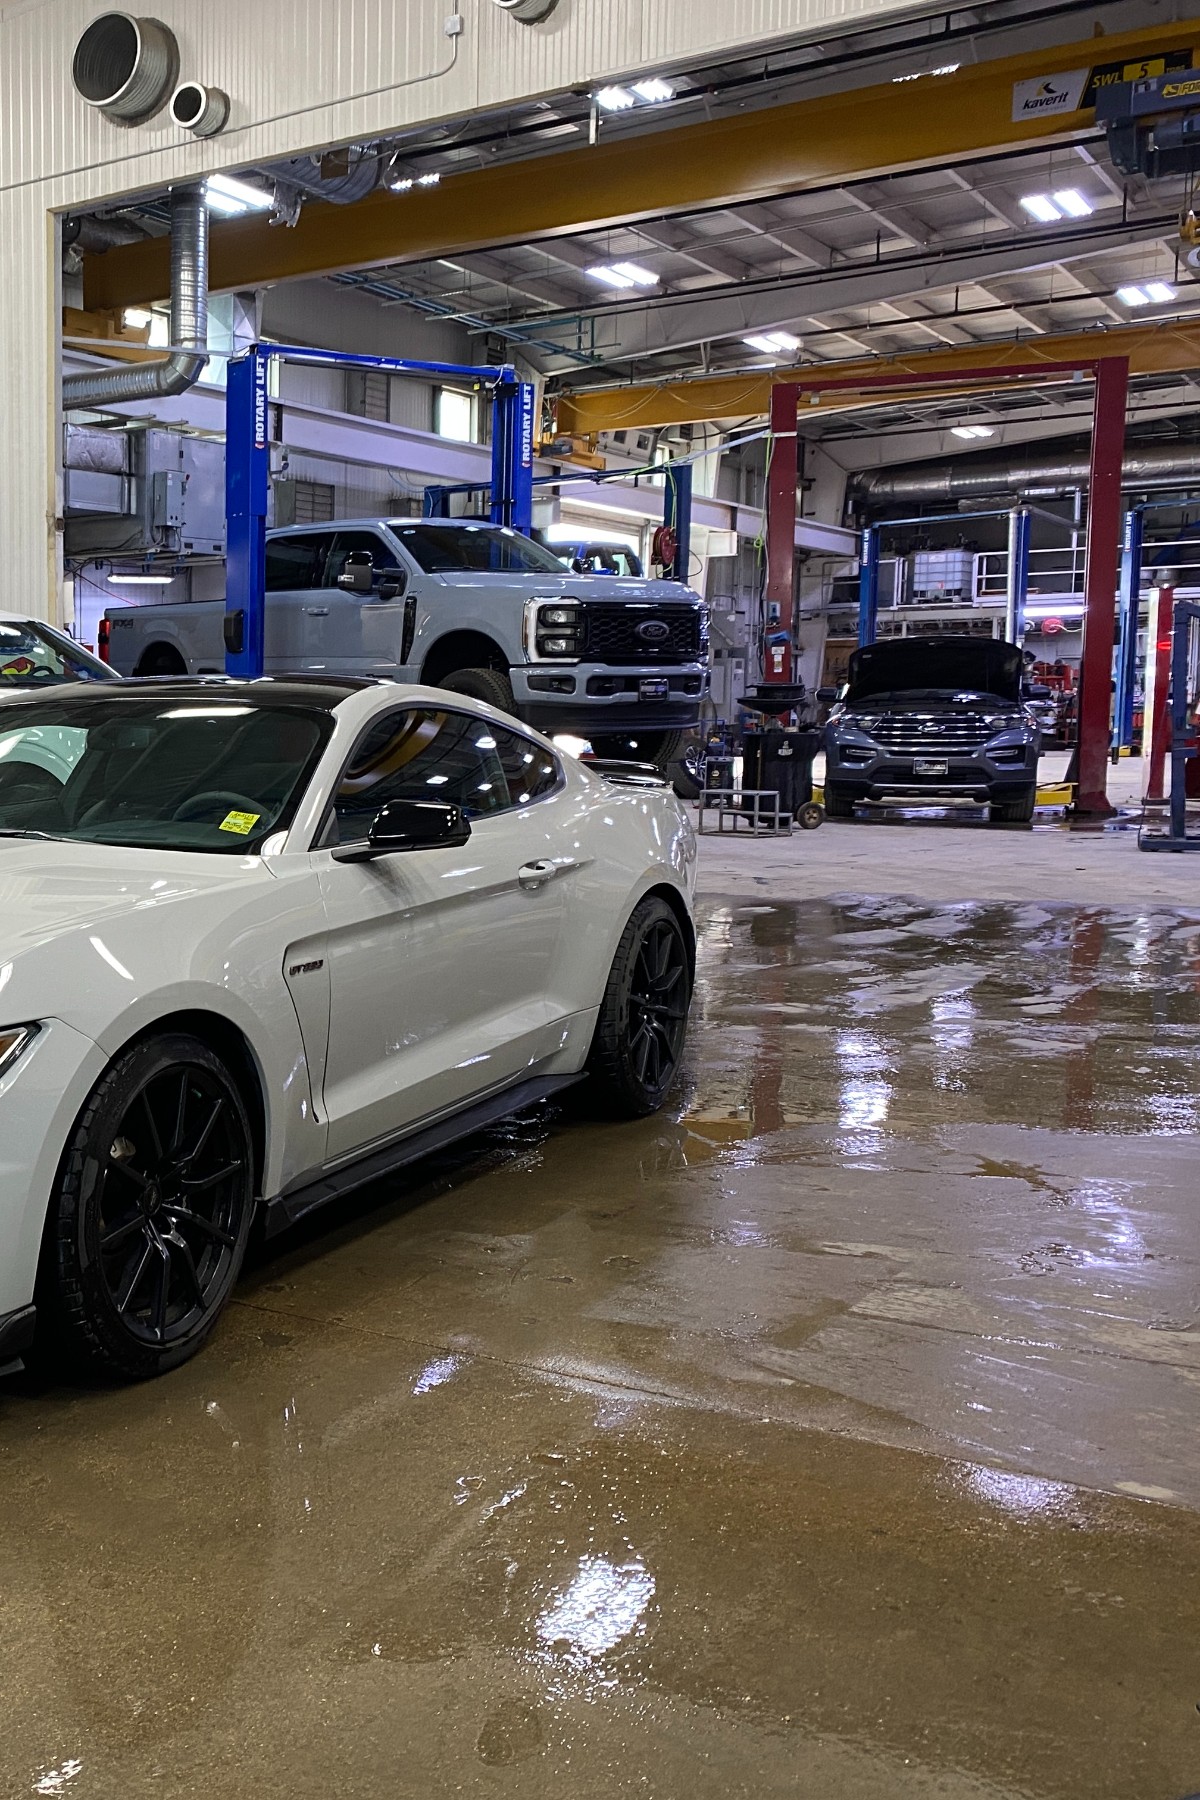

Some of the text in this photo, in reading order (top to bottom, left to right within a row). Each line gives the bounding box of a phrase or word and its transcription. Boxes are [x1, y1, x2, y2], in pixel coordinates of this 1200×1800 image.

[1023, 91, 1069, 110] kaverit
[1091, 71, 1122, 88] SWL
[1138, 62, 1149, 79] 5
[255, 355, 265, 442] ROTARY LIFT
[522, 383, 532, 461] ROTARY LIFT
